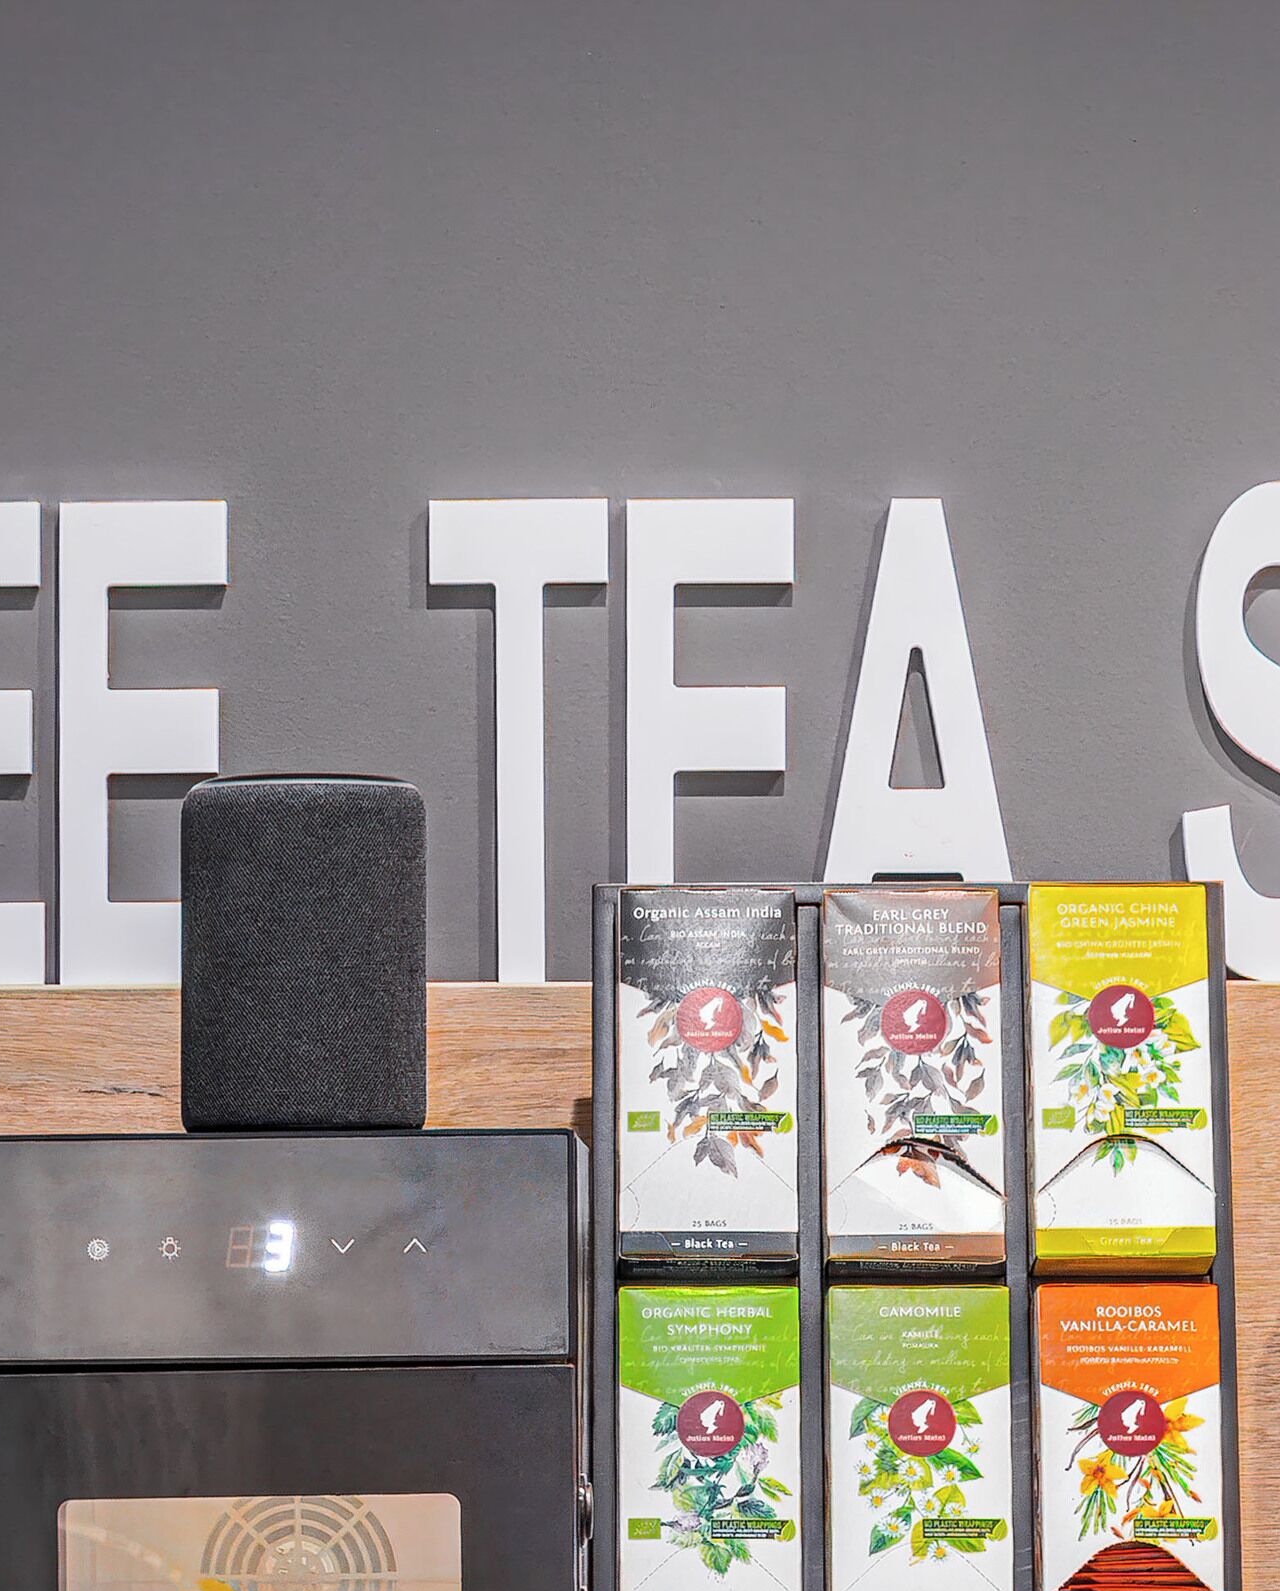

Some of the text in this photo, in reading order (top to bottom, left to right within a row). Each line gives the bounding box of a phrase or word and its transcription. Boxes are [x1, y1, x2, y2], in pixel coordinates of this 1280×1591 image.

[428, 497, 1011, 984] TEA
[633, 906, 782, 922] Organic Assam India
[873, 909, 949, 921] EARL GREY
[1057, 903, 1179, 915] ORGANIC CHINA
[835, 923, 987, 935] TRADITIONAL BLEND
[1060, 917, 1175, 930] GREEN JASMINE
[685, 1239, 734, 1248] Black Tea
[891, 1242, 940, 1252] Black Tea
[641, 1307, 773, 1319] ORGANIC HERBAL
[880, 1307, 961, 1318] CAMOMILE
[1096, 1306, 1162, 1317] ROOIBOS
[667, 1324, 752, 1336] SYMPHONY
[1061, 1320, 1197, 1332] VANILLA-CARAMEL
[722, 1520, 746, 1529] PLASTIC
[934, 1520, 958, 1528] PLASTIC
